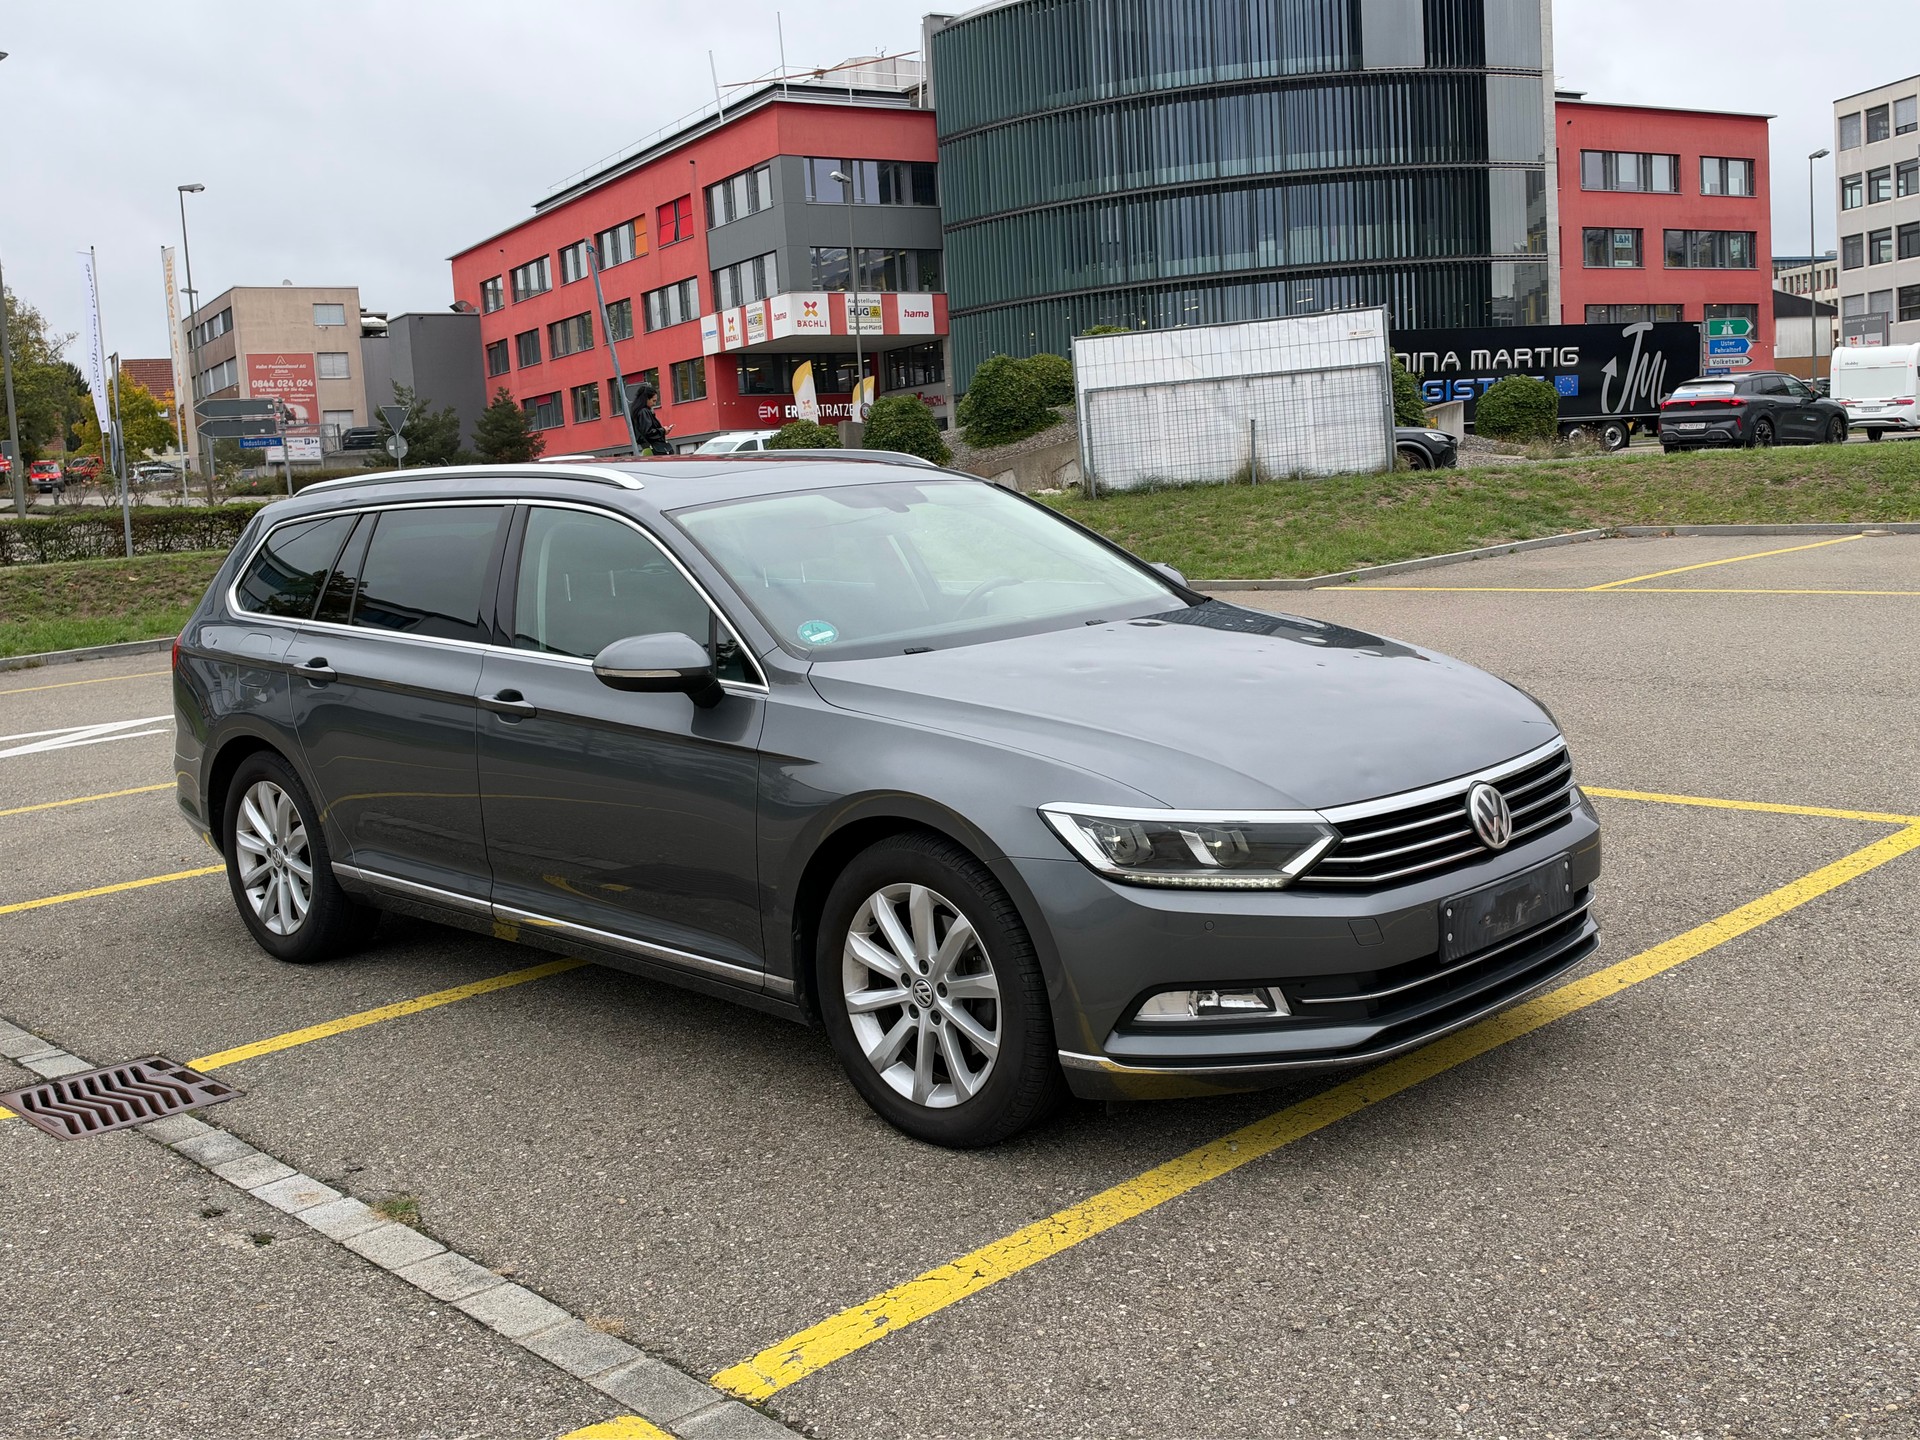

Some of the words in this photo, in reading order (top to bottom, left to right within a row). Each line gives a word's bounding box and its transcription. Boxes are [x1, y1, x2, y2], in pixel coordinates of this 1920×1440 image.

[849, 307, 870, 316] HUG
[904, 309, 929, 318] hama
[748, 316, 758, 326] HUG
[774, 312, 787, 321] hama
[797, 319, 827, 328] BÄCHLI
[1861, 323, 1866, 332] 1
[1394, 351, 1462, 373] NINA
[1470, 346, 1580, 371] MARTIG
[252, 379, 275, 388] 0844
[277, 379, 294, 388] 024
[296, 379, 313, 387] 024
[759, 405, 779, 418] EM
